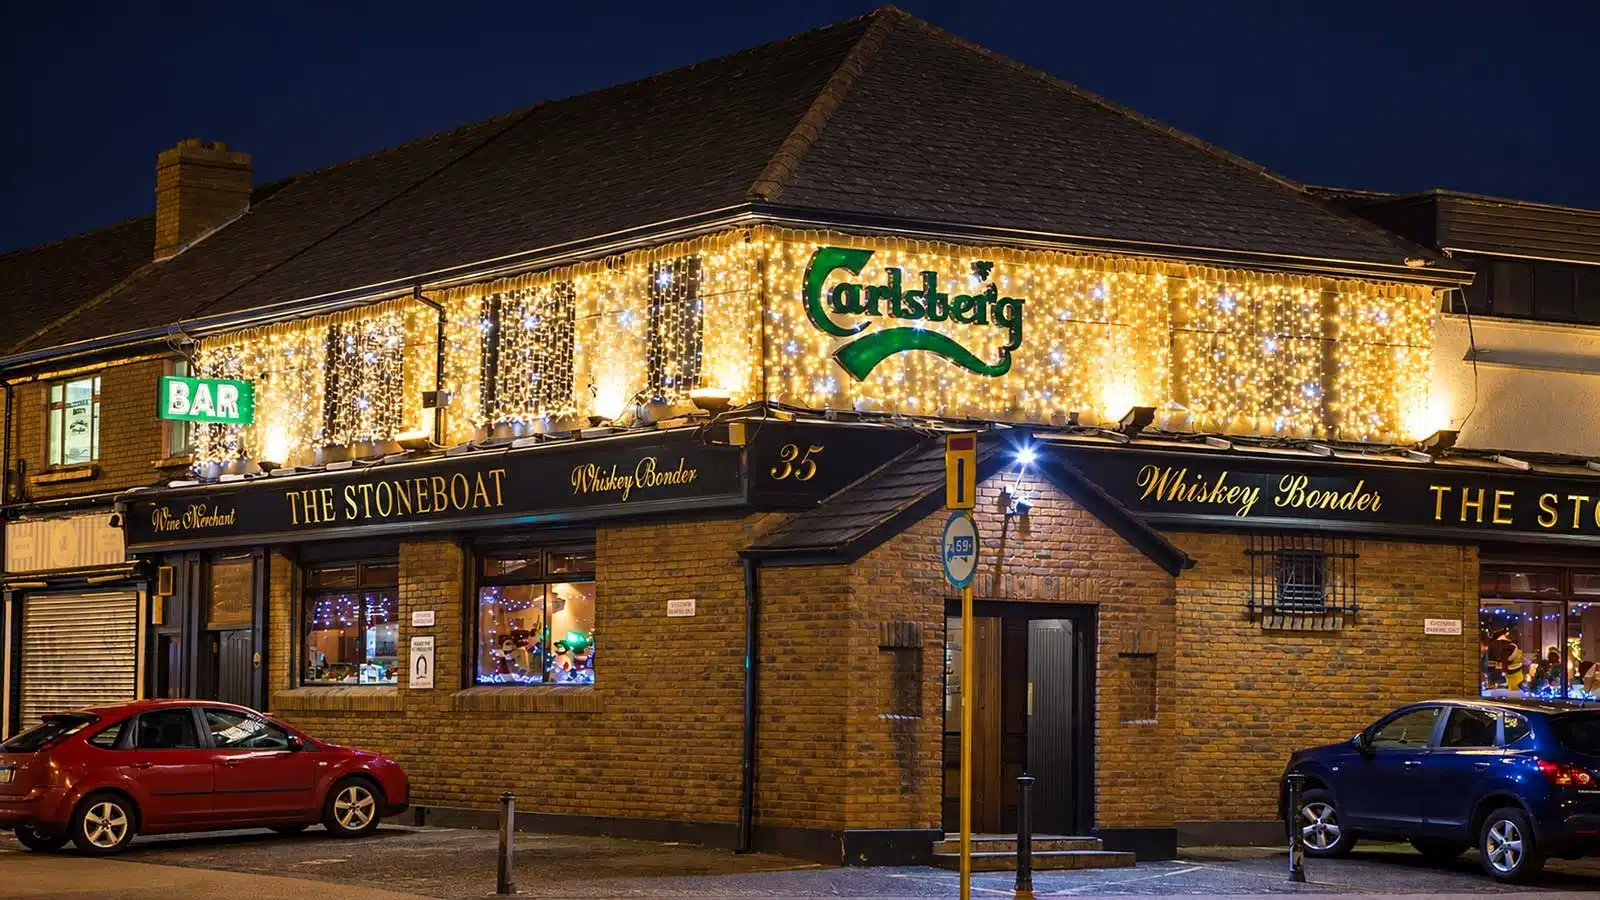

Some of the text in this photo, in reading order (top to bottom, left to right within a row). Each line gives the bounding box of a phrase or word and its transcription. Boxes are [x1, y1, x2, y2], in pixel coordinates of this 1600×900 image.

[802, 246, 1025, 353] Carlsberg
[168, 381, 240, 419] BAR
[571, 456, 698, 502] Whiskey Bonder
[770, 443, 825, 481] 35
[286, 468, 506, 525] THE STONEBOAT
[1136, 464, 1382, 518] Whiskey Bonder
[1429, 485, 1600, 529] THE ST
[151, 503, 237, 534] Wine Merchant
